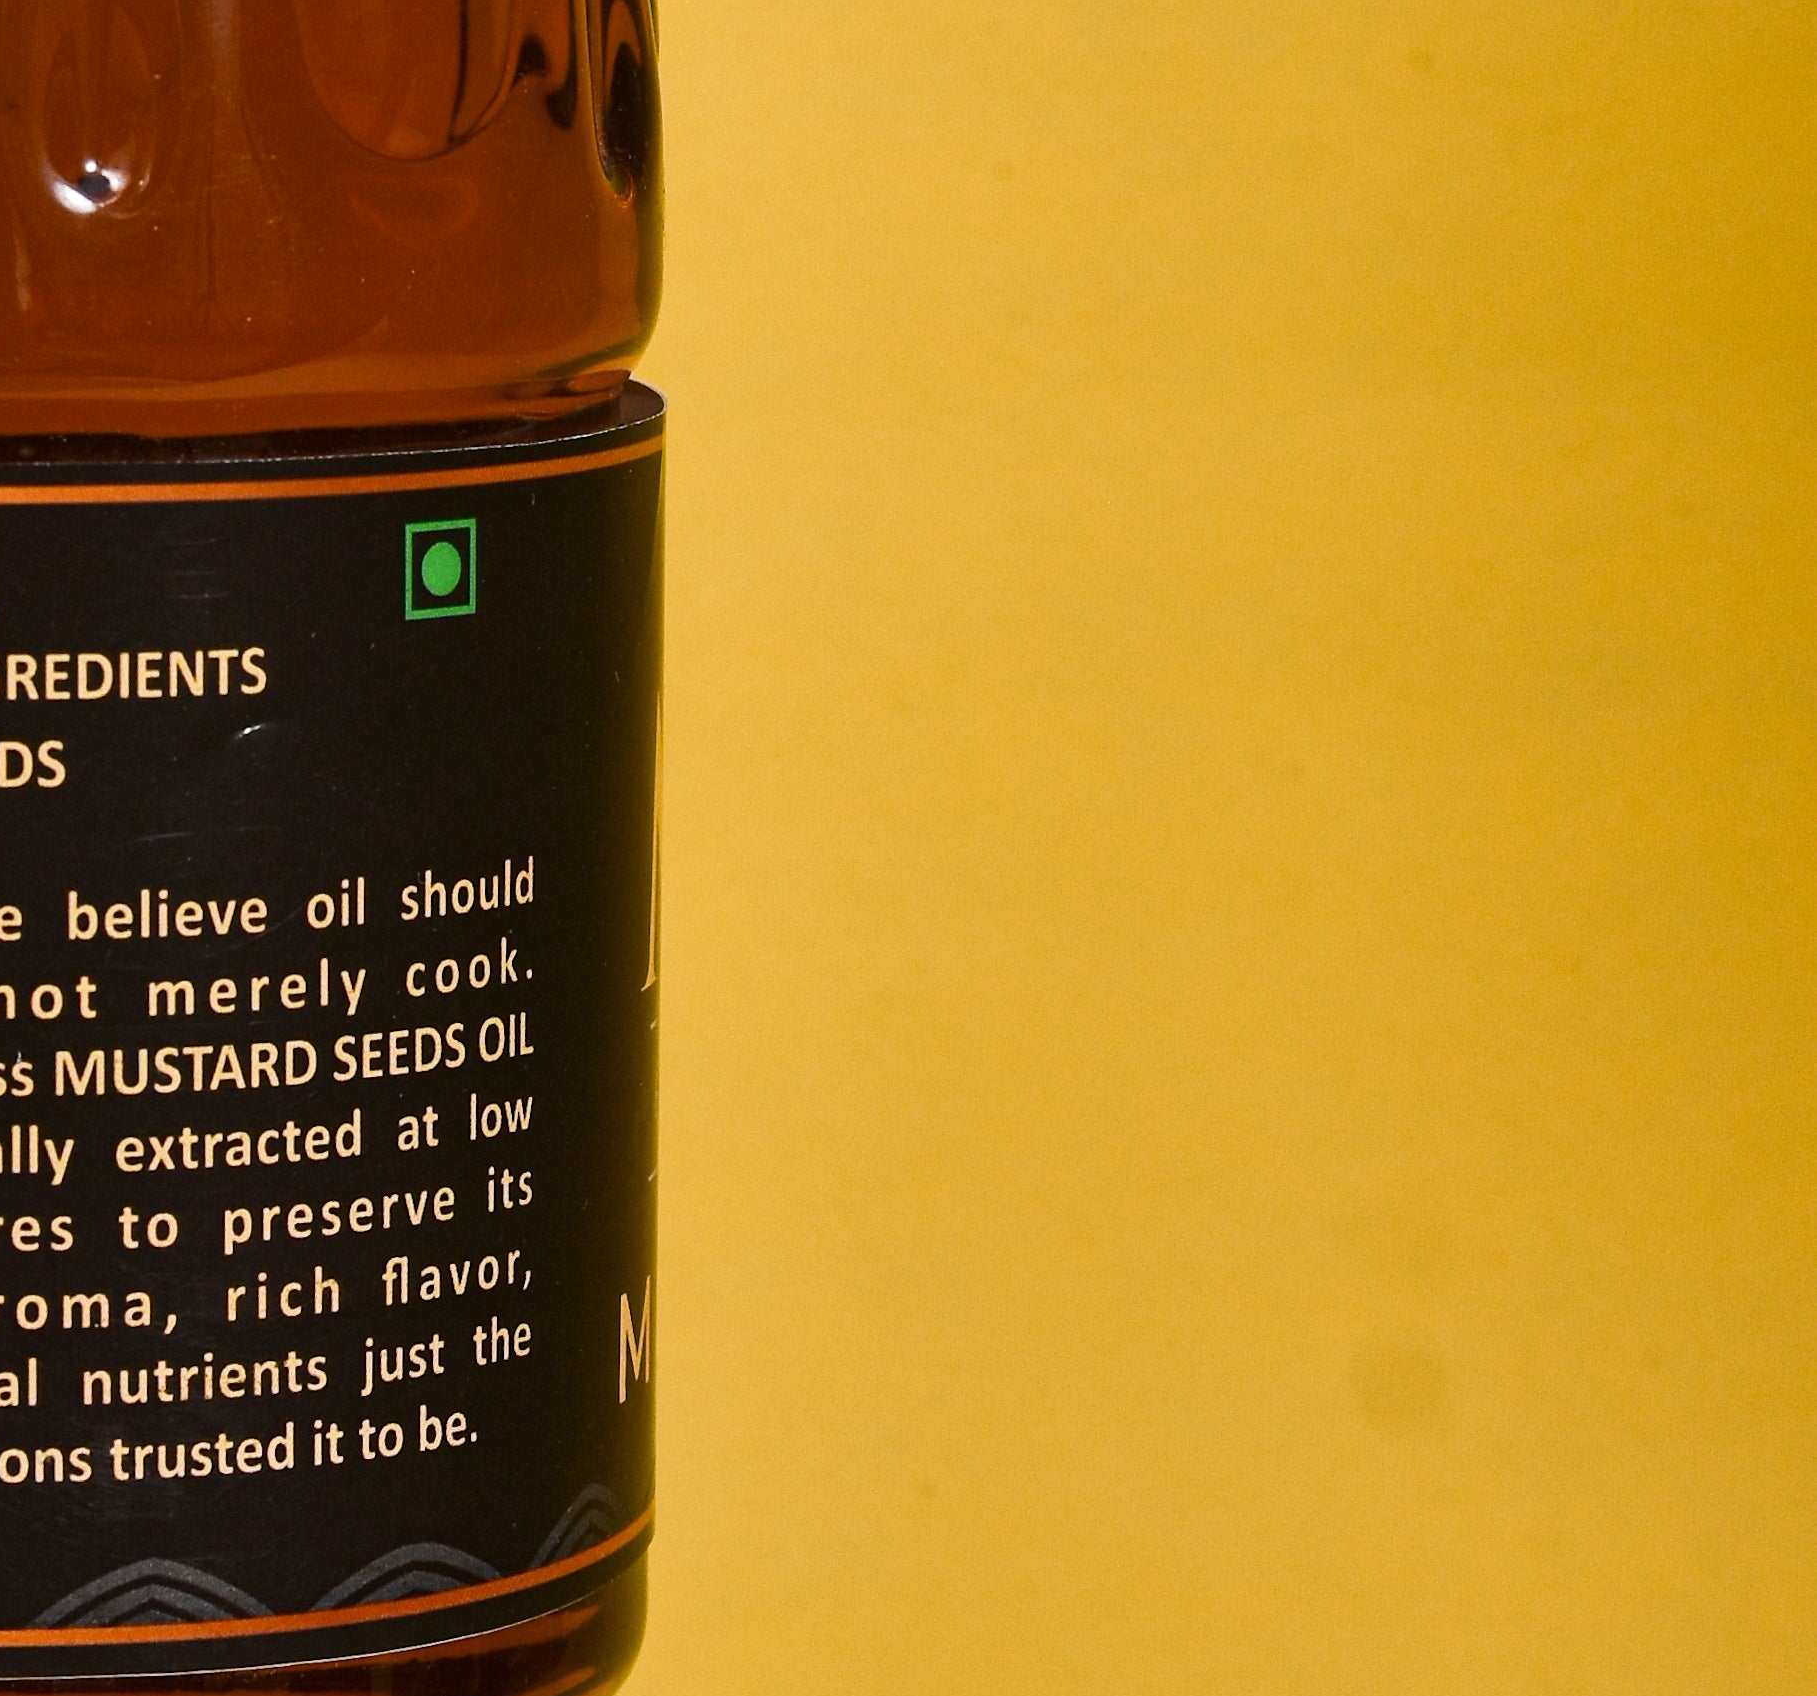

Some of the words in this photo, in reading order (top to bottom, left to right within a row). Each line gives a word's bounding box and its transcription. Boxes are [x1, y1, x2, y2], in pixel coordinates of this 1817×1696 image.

[66, 887, 269, 942] believe
[305, 875, 366, 930] oil
[399, 854, 535, 922] should
[147, 956, 368, 1018] merely
[404, 935, 534, 998] cook.
[53, 1038, 318, 1098] MUSTARD
[332, 1021, 467, 1083] SEEDS
[477, 1010, 536, 1064] OIL
[114, 1106, 363, 1174] extracted
[396, 1104, 440, 1152] at
[468, 1091, 534, 1142] low
[117, 1205, 180, 1251] to
[223, 1185, 456, 1255] preserve
[486, 1164, 534, 1214] its
[226, 1264, 341, 1323] rich
[380, 1248, 533, 1307] flavor,
[81, 1349, 329, 1407] nutrients
[359, 1332, 446, 1398] just
[471, 1314, 533, 1367] the
[108, 1420, 296, 1483] trusted
[312, 1418, 345, 1467] it
[357, 1417, 405, 1461] to
[418, 1403, 479, 1453] be.
